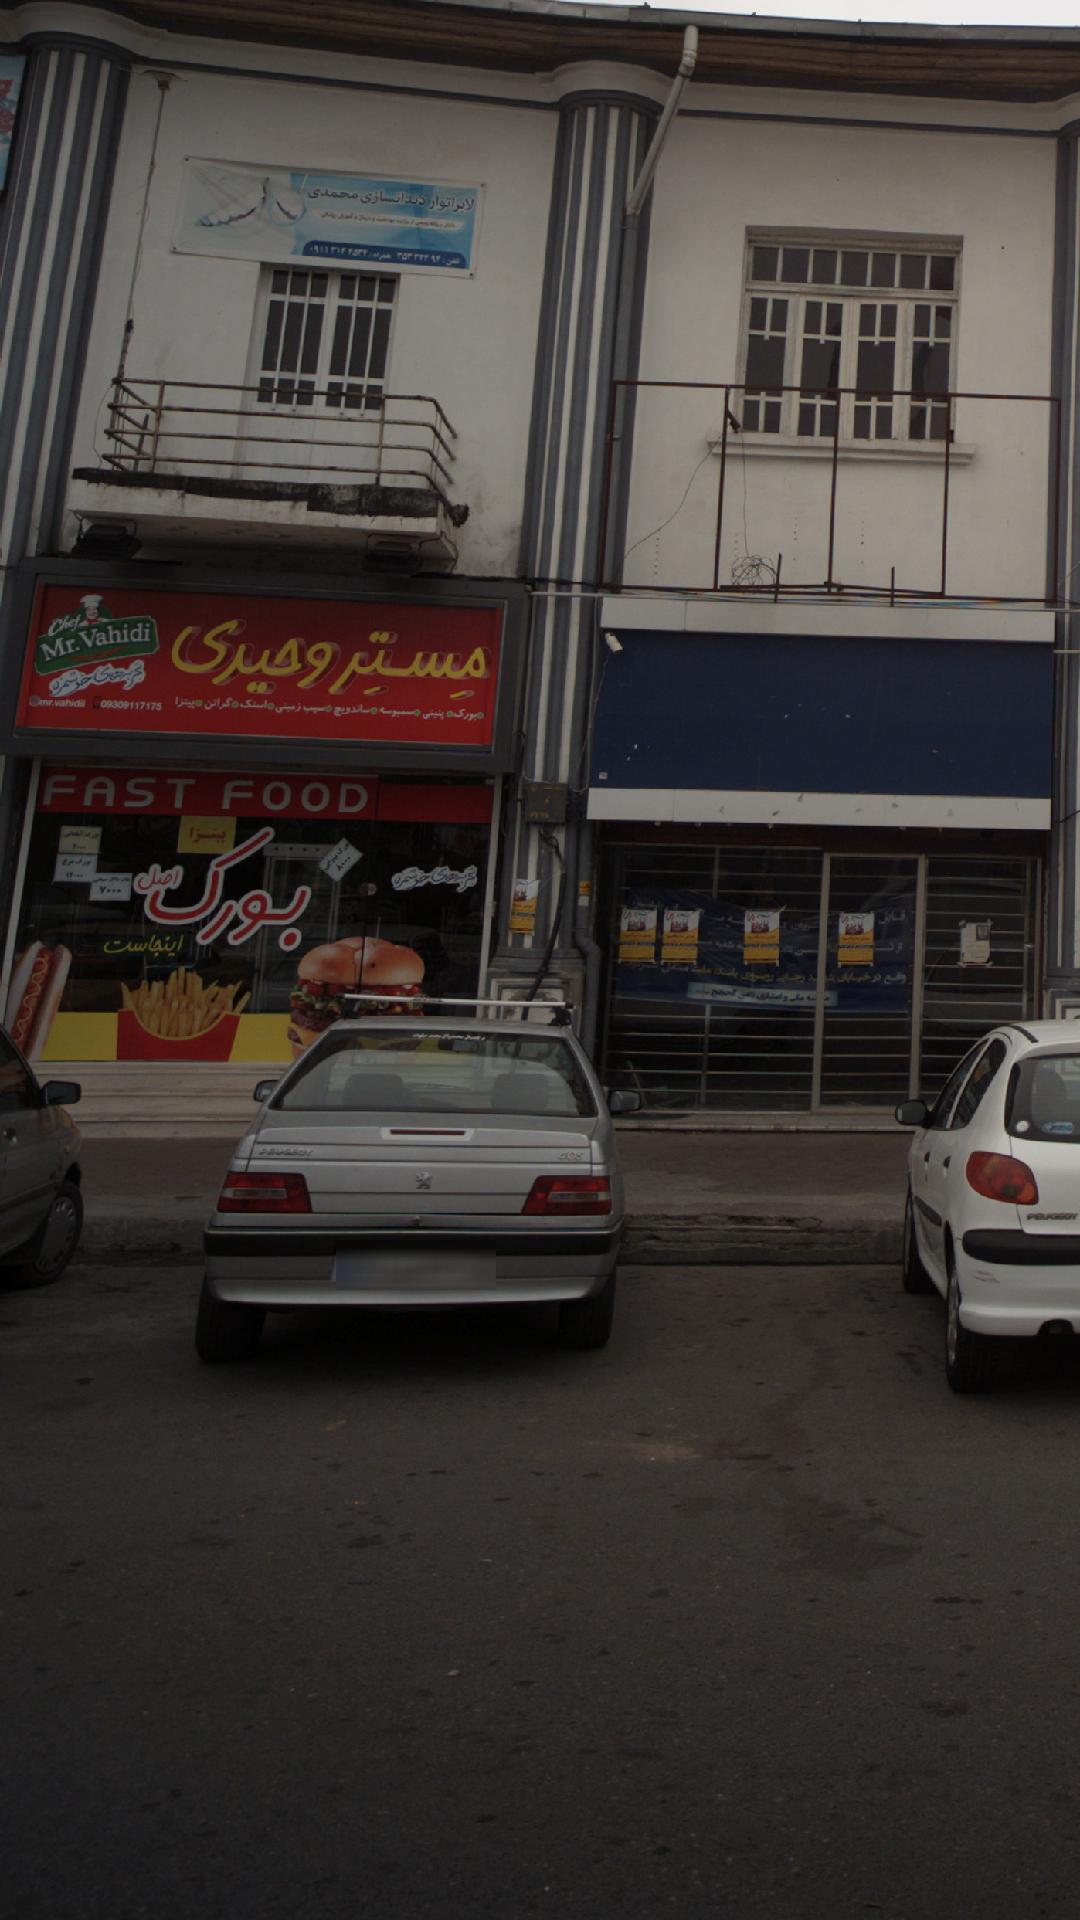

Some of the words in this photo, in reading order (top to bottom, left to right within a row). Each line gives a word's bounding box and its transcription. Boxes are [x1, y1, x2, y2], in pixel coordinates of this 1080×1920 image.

[307, 186, 358, 201] محمدی
[48, 614, 82, 637] Chef
[40, 637, 80, 661] Mr.
[78, 622, 151, 648] Vahidi
[171, 619, 334, 694] وحیدی
[42, 775, 197, 809] FAST
[221, 779, 369, 812] FOOD
[99, 885, 121, 894] ۷۰۰۰
[135, 863, 182, 892] اصل
[146, 828, 309, 950] بورک
[103, 931, 185, 955] اینجاست
